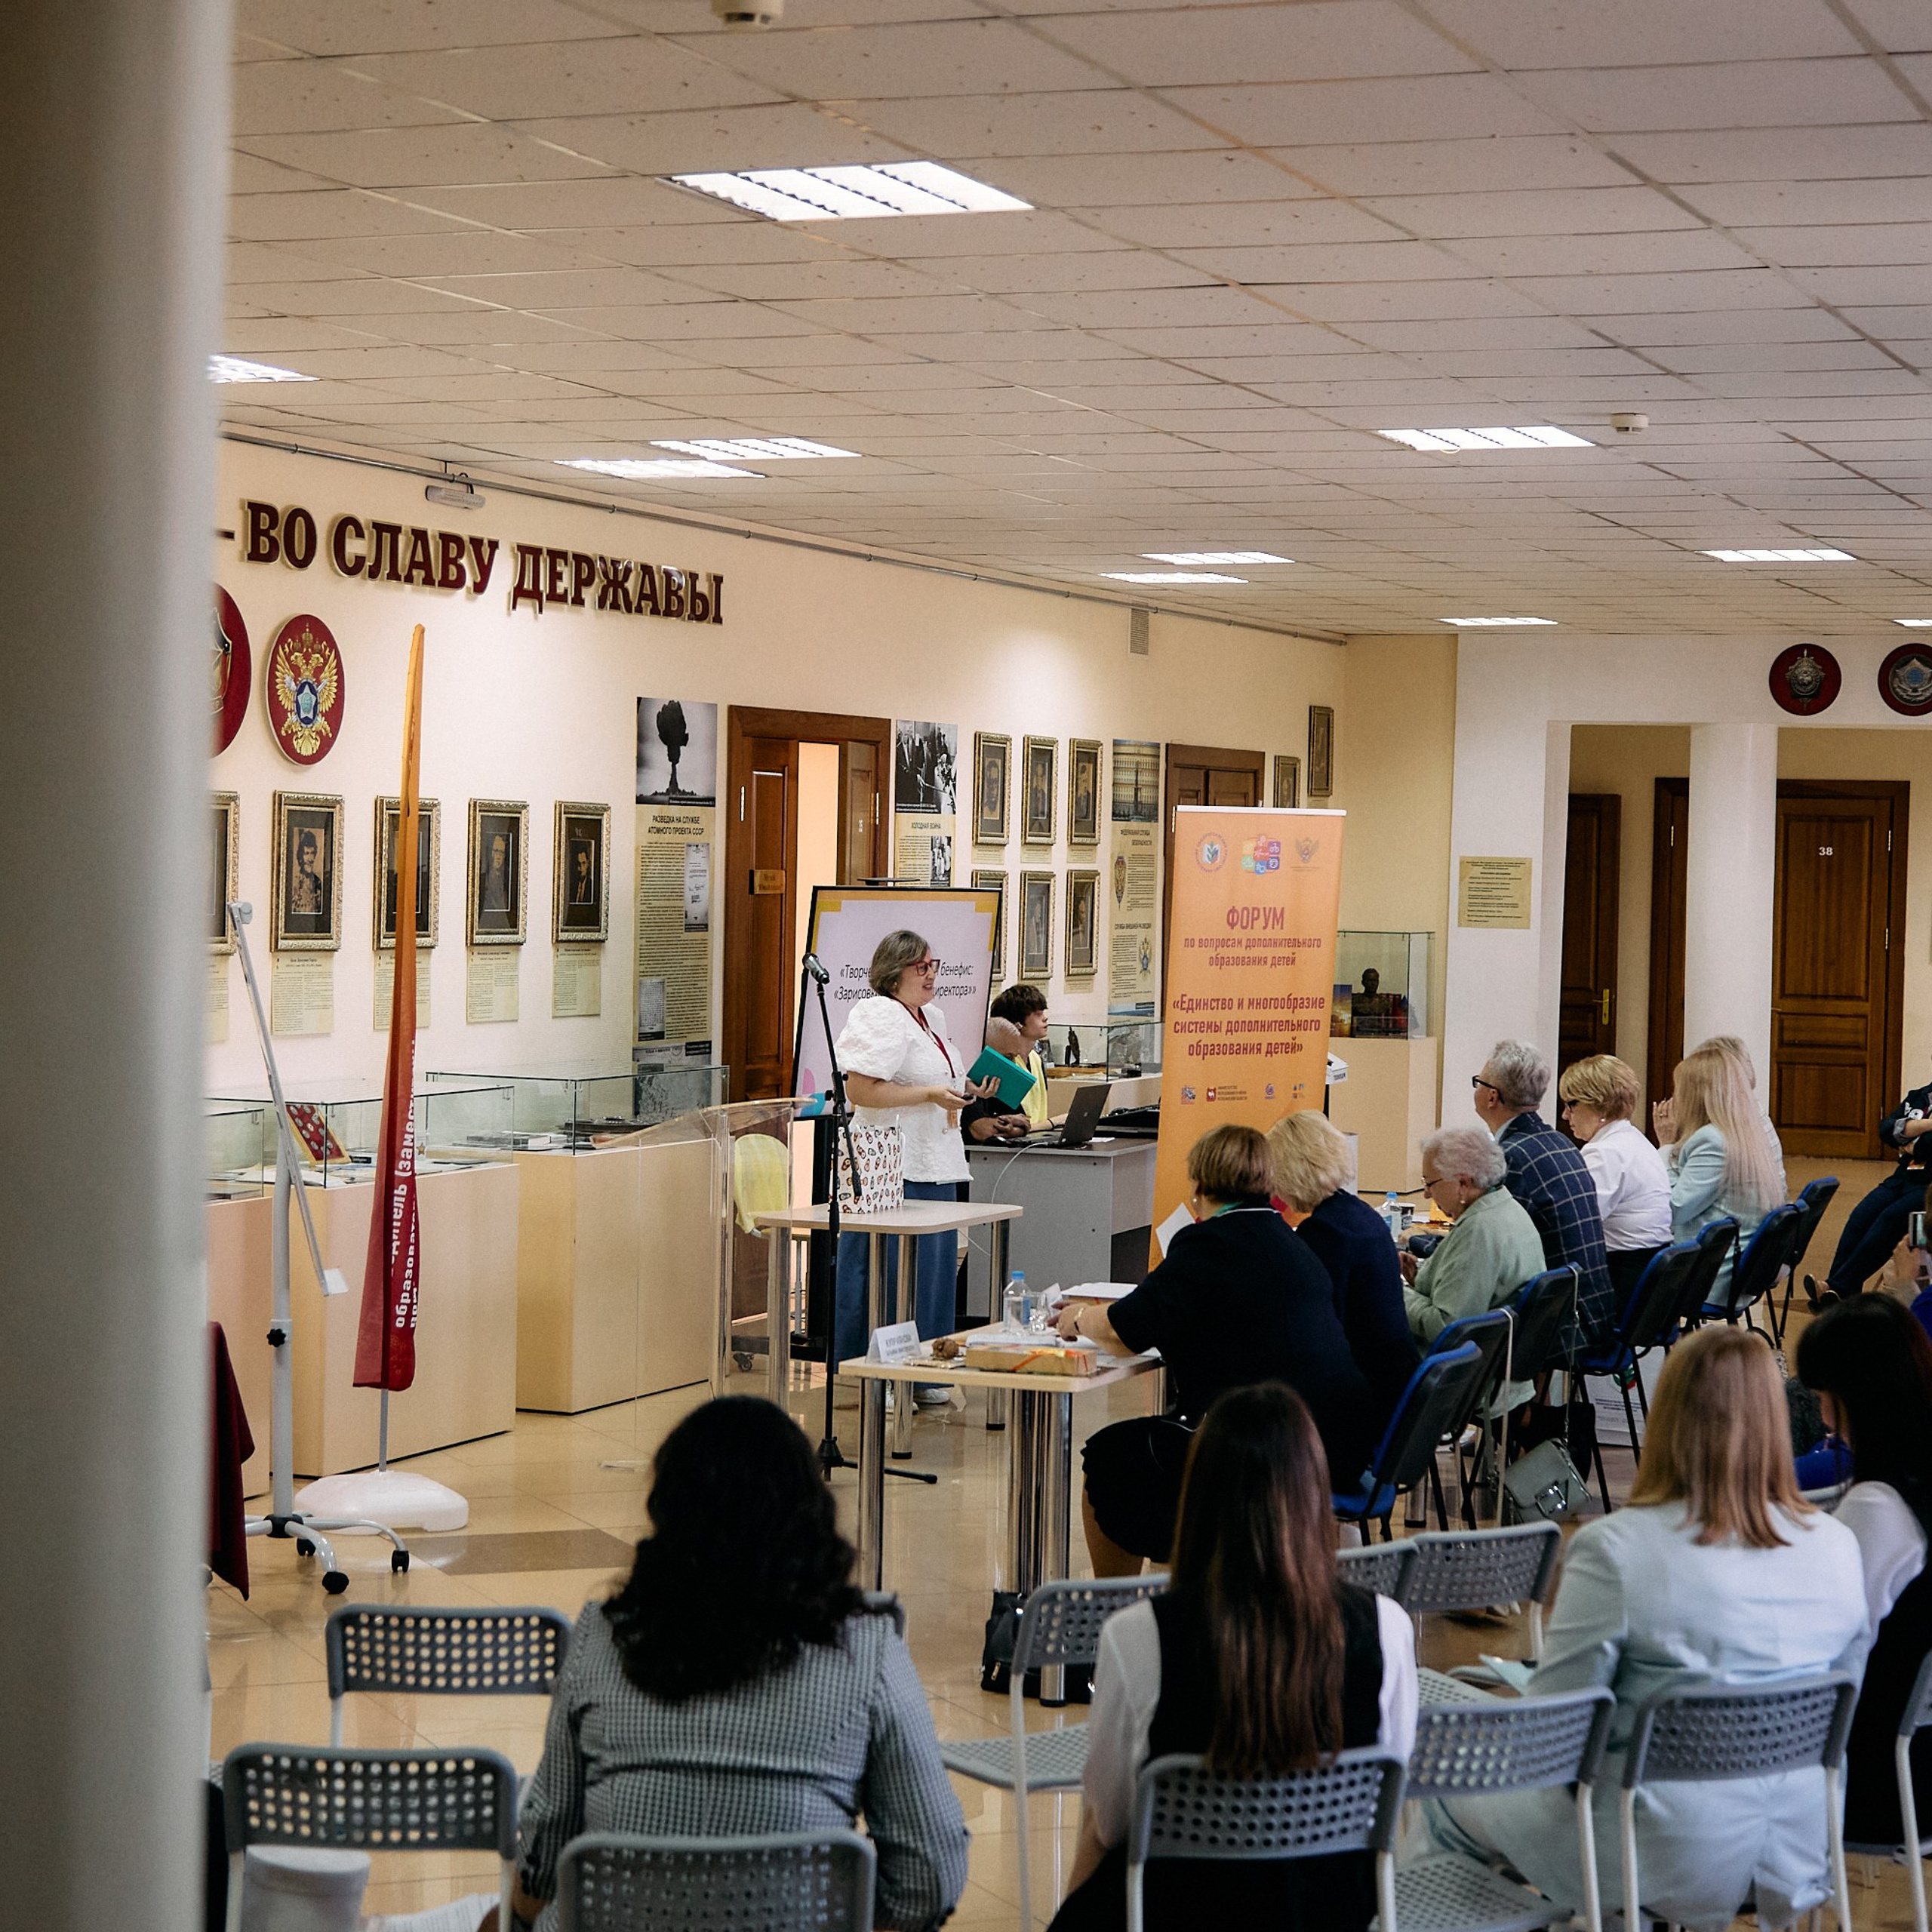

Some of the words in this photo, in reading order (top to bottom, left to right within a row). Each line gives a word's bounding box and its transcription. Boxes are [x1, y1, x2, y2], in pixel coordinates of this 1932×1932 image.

[243, 499, 318, 571] ВО
[333, 515, 500, 595] СЛАВУ
[511, 543, 724, 625] ДЕРЖАВЫ
[652, 815, 675, 823] РАЗВЕДКА
[648, 826, 672, 835] АТОМНОГО
[672, 826, 692, 835] ПРОЕКТА
[693, 827, 704, 835] СССР
[1819, 847, 1833, 856] 38
[1226, 906, 1284, 930] ФОРУМ
[1184, 938, 1195, 948] по
[1198, 938, 1242, 951] вопросам
[1245, 937, 1321, 950] дополнительного
[1209, 953, 1268, 970] образования
[1270, 952, 1296, 968] детей
[840, 964, 871, 981] «Творче
[940, 961, 974, 978] бенефис:
[933, 986, 977, 1000] иректора»»
[1173, 994, 1233, 1013] «Единство
[1238, 998, 1244, 1010] и
[1247, 993, 1325, 1014] многообразие
[1174, 1020, 1222, 1033] системы
[1226, 1019, 1321, 1035] дополнительного
[1188, 1040, 1262, 1060] образования
[1265, 1036, 1303, 1057] детей»
